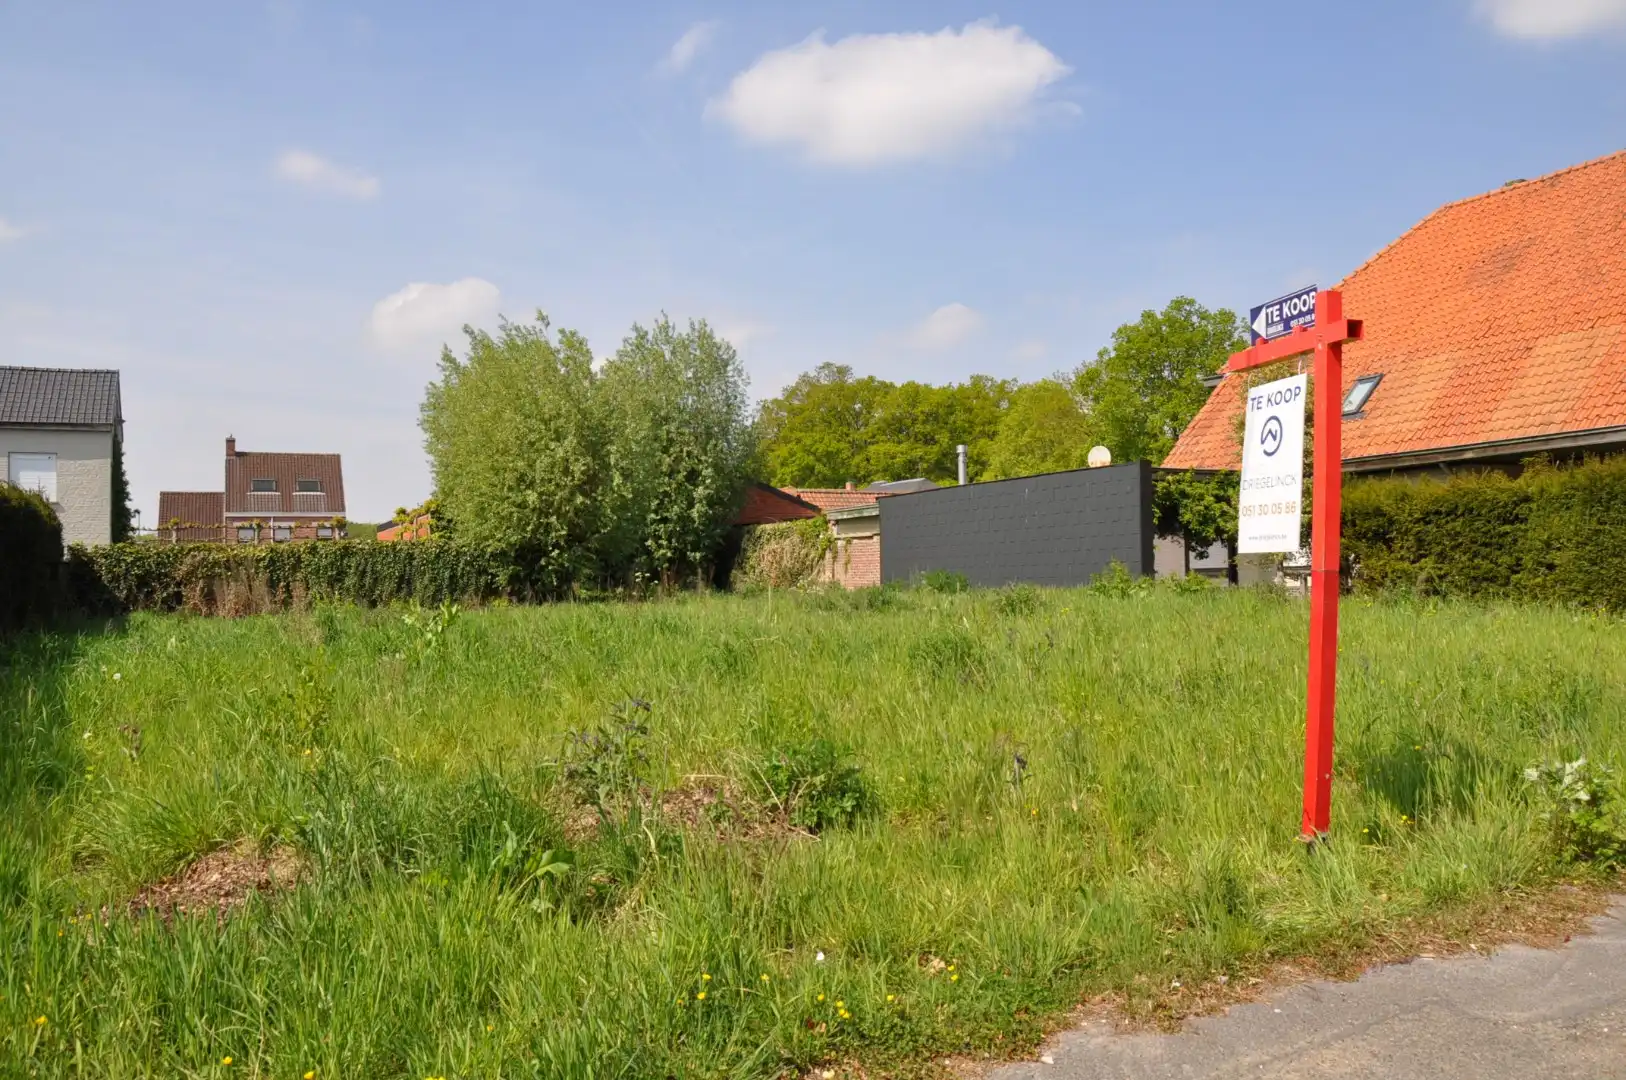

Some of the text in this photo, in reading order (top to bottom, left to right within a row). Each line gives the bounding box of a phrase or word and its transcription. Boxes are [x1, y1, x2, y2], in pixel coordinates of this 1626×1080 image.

[1266, 291, 1316, 323] TE KOOP
[1251, 386, 1301, 412] TE KOOP
[1242, 475, 1296, 490] DRIEGELINCK
[1242, 500, 1296, 517] 051 30 05 86
